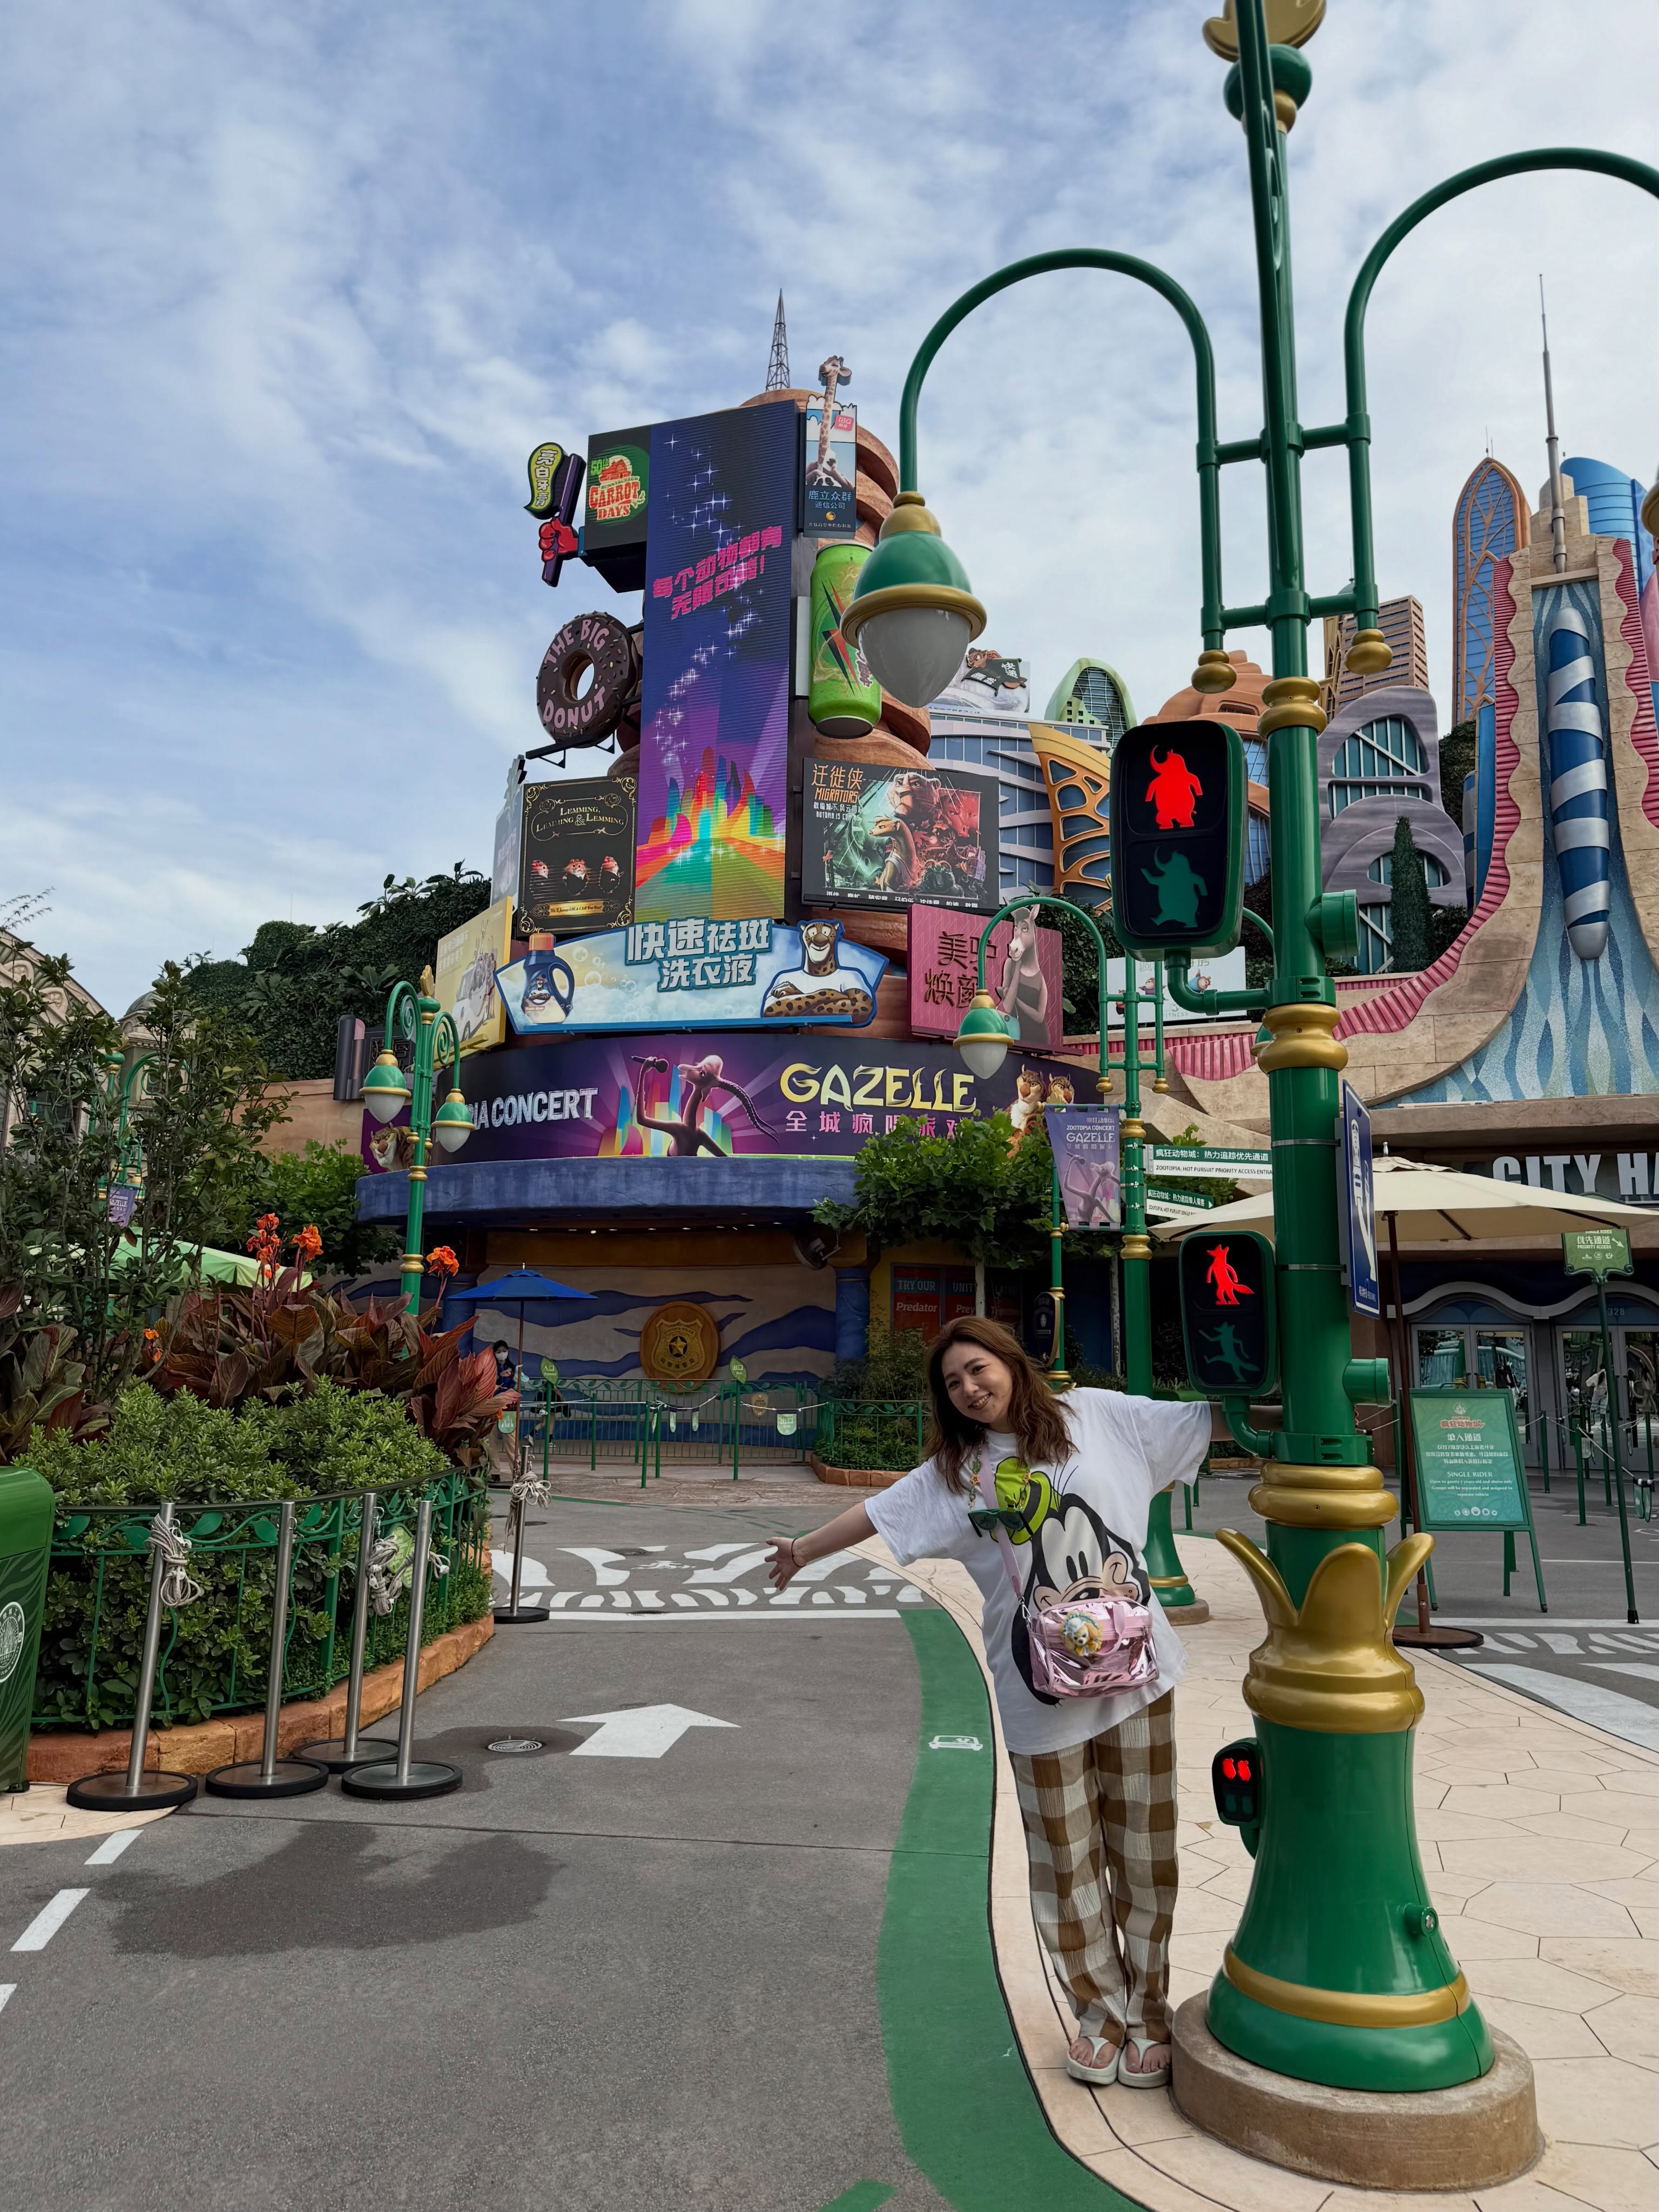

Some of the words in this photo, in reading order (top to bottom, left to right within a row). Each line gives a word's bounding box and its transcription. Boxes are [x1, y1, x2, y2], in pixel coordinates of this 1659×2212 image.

[535, 449, 558, 506] 亮白牙膏
[589, 482, 640, 508] CARROT
[808, 490, 852, 501] 鹿立众群
[597, 505, 630, 520] DAYS
[653, 525, 782, 598] 每个动物都有
[544, 624, 575, 664] THE
[581, 619, 610, 651] BIG
[543, 686, 605, 728] DONUT
[812, 764, 864, 790] 迁徙侠
[815, 787, 859, 803] MIGRATORS
[575, 814, 586, 826] &
[628, 918, 769, 961] 快速祛斑
[661, 953, 753, 989] 洗衣液
[780, 1063, 976, 1112] GAZELLE
[491, 1088, 598, 1128] CONCERT
[1066, 1132, 1115, 1143] GAZELLE
[1493, 1155, 1601, 1193] CITY
[1617, 1152, 1659, 1195] H
[1577, 1236, 1610, 1244] 优先通道
[898, 1280, 915, 1291] TRY
[918, 1280, 935, 1291] OUR
[896, 1302, 938, 1312] Predator
[956, 1305, 975, 1314] Prey
[1447, 1433, 1482, 1441] 单人通道
